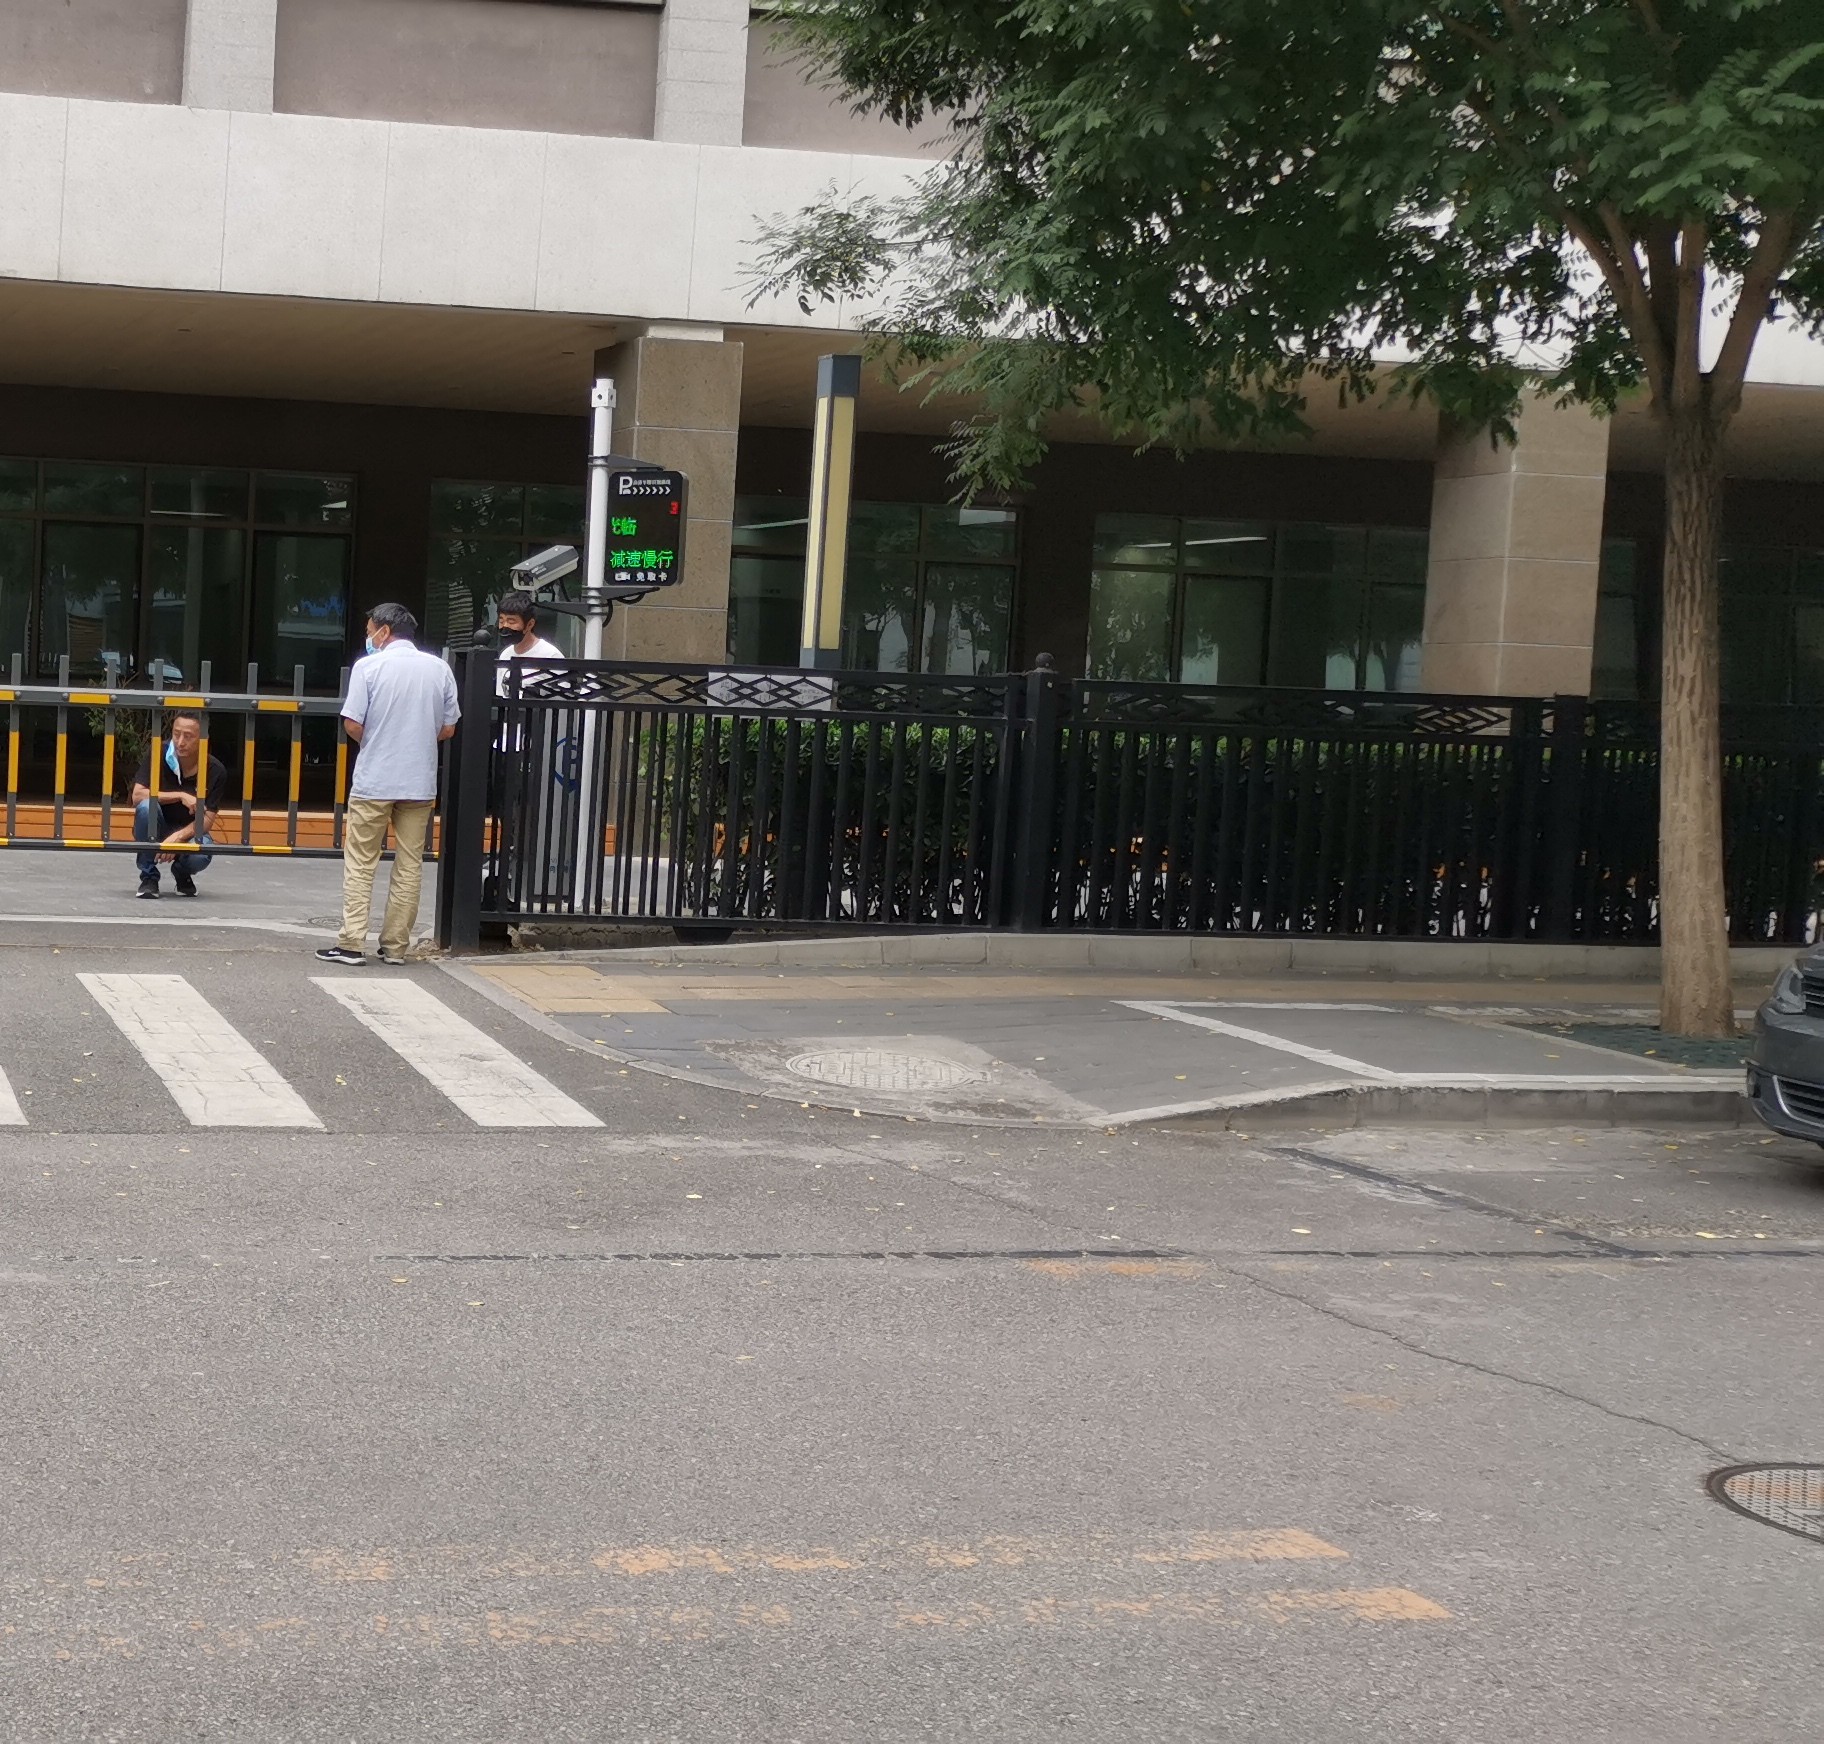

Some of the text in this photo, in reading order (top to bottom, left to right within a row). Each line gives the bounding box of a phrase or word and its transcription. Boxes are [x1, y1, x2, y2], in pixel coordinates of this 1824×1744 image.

[610, 549, 674, 569] 减速慢行
[636, 571, 668, 582] 免取卡
